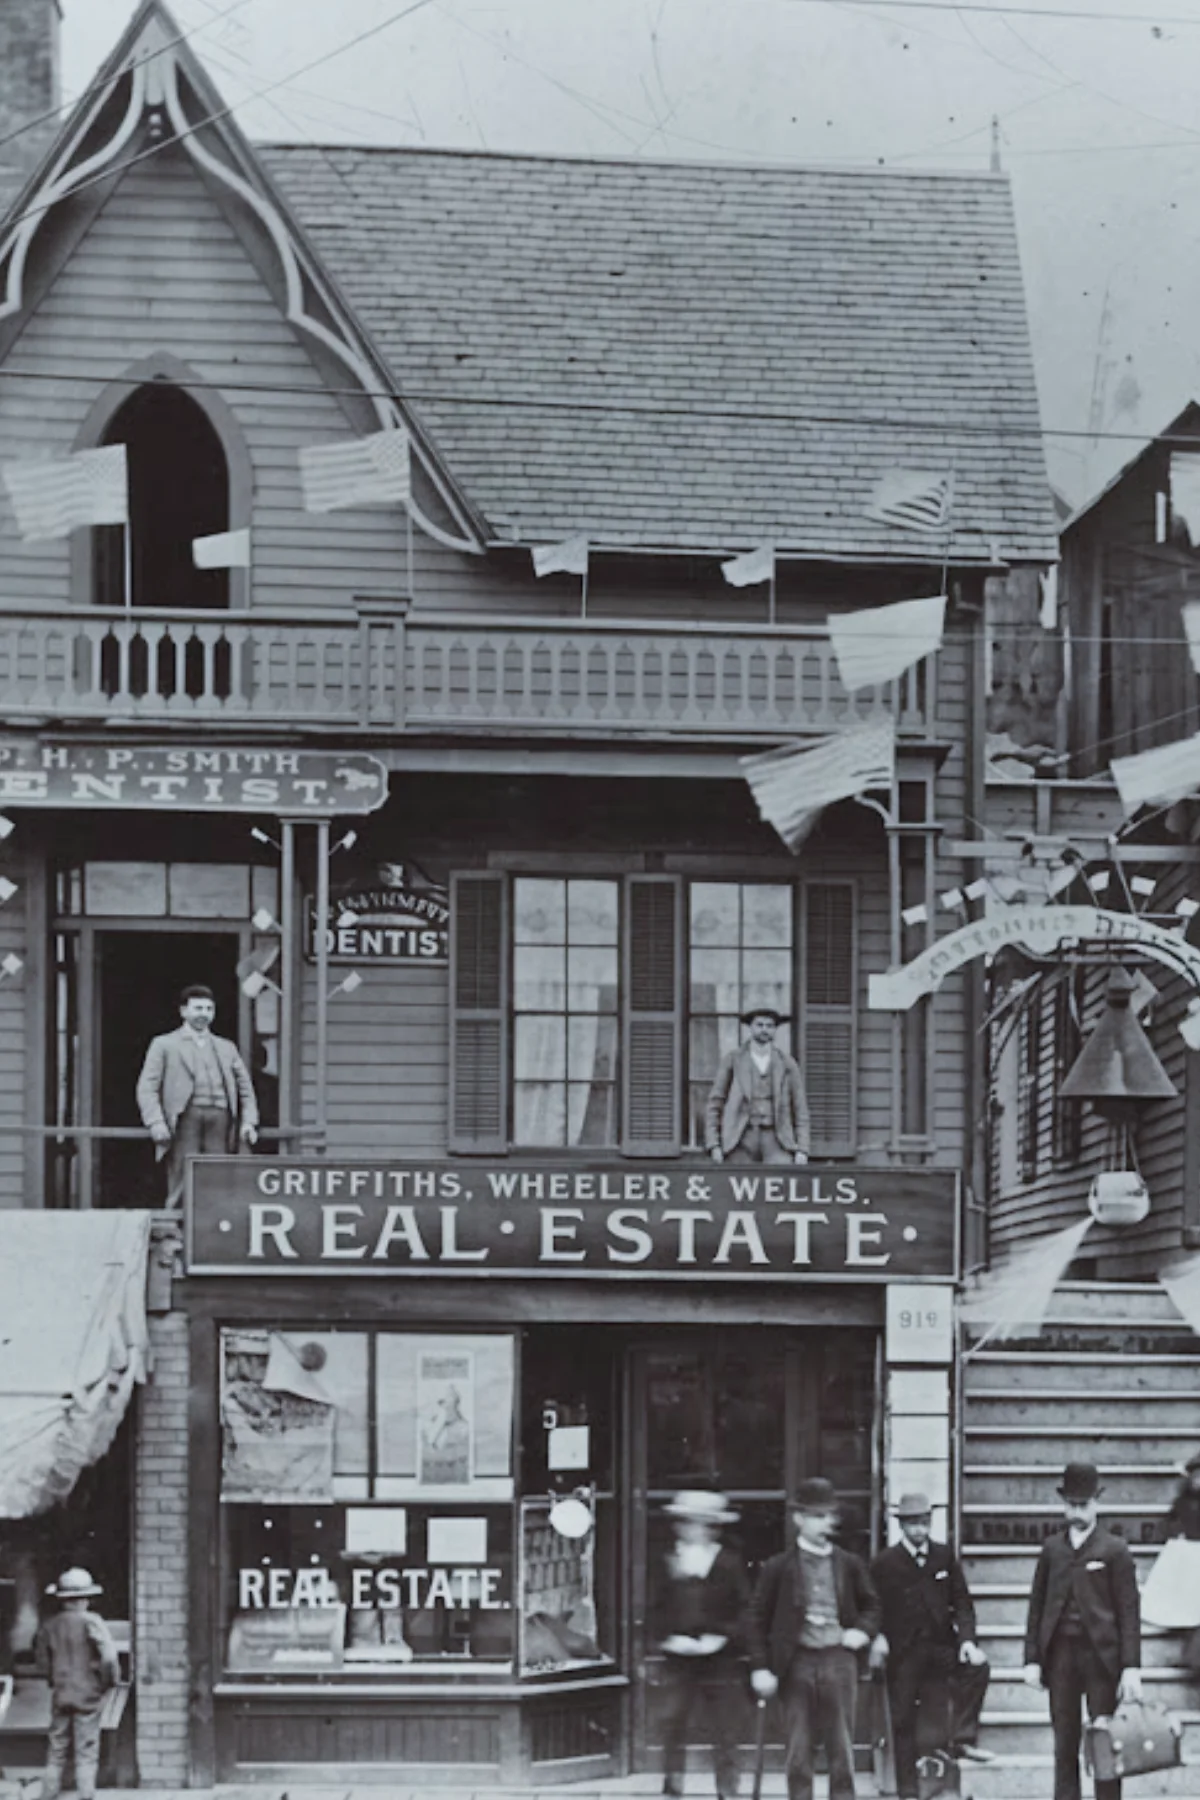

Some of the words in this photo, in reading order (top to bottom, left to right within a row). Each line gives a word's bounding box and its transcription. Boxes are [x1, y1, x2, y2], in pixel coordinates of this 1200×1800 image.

[166, 752, 300, 774] SMITH
[258, 1168, 473, 1200] GRIFFITHS,
[487, 1174, 670, 1200] WHEELER
[685, 1175, 712, 1201] &
[729, 1176, 870, 1205] WELLS.
[247, 1203, 490, 1261] REAL
[539, 1206, 891, 1267] ESTATE
[238, 1568, 347, 1609] REAL
[351, 1568, 511, 1610] ESTATE.
